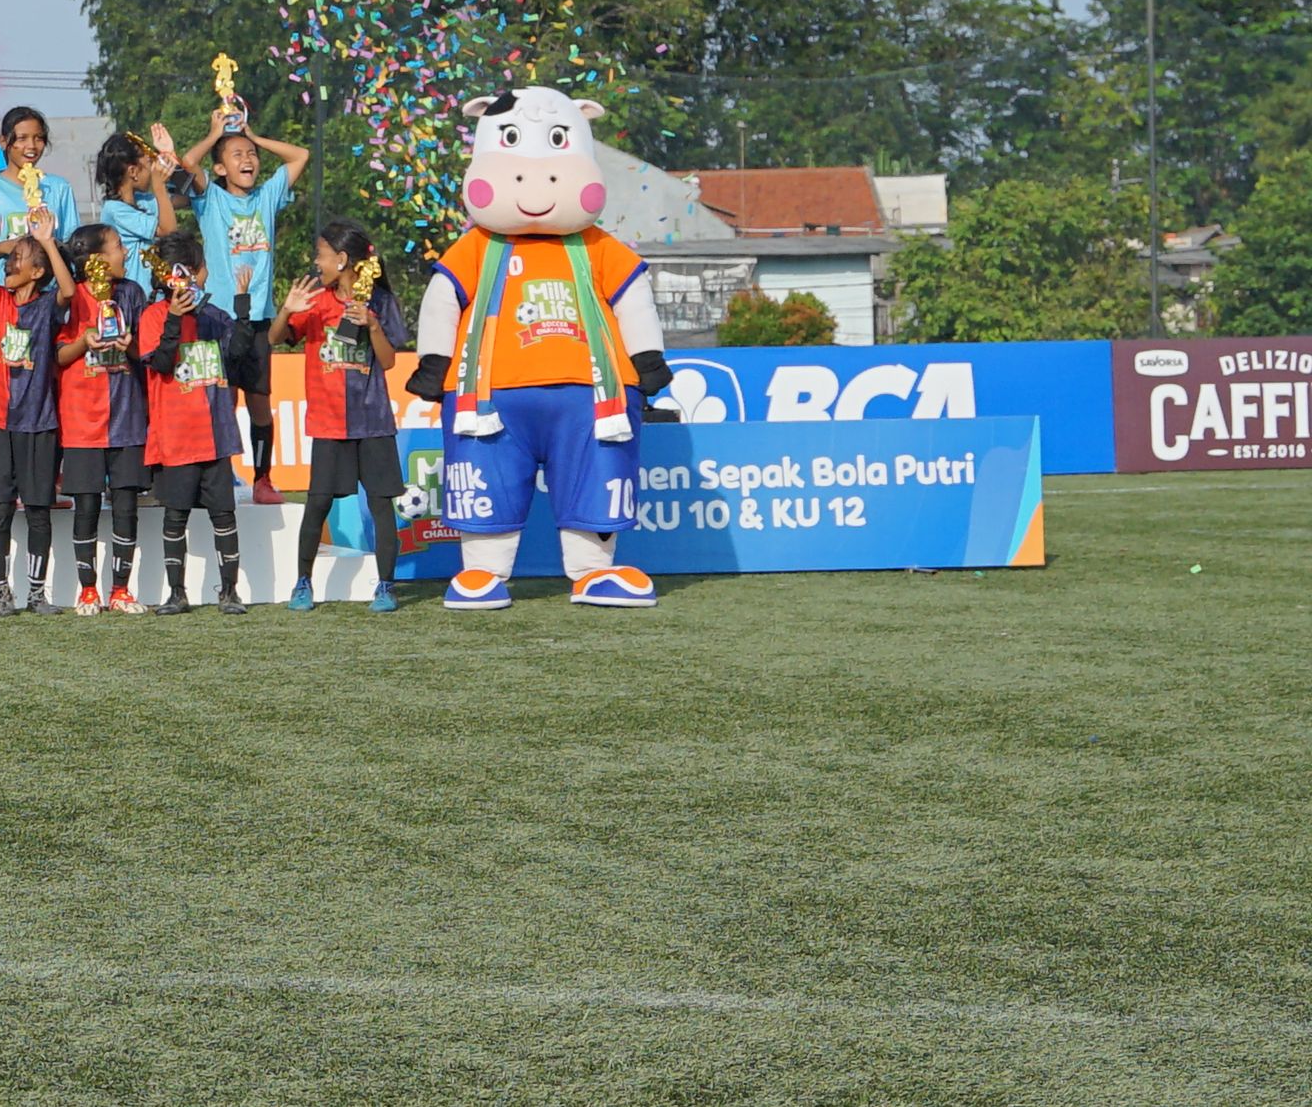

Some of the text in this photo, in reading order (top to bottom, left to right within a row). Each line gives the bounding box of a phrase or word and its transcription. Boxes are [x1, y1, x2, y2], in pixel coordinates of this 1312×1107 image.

[528, 281, 573, 303] Milk
[538, 301, 578, 321] Life
[185, 344, 217, 365] Milk
[1140, 355, 1184, 368] SAVORIA
[1219, 349, 1312, 376] DELIZIO
[766, 362, 976, 422] BCA
[1150, 381, 1312, 461] CAFFI
[699, 456, 805, 497] Sepak
[812, 454, 888, 488] Bola
[894, 453, 975, 486] Putri
[447, 490, 494, 520] Life
[605, 477, 635, 519] 10
[635, 496, 867, 532] KU 10 & KU 12
